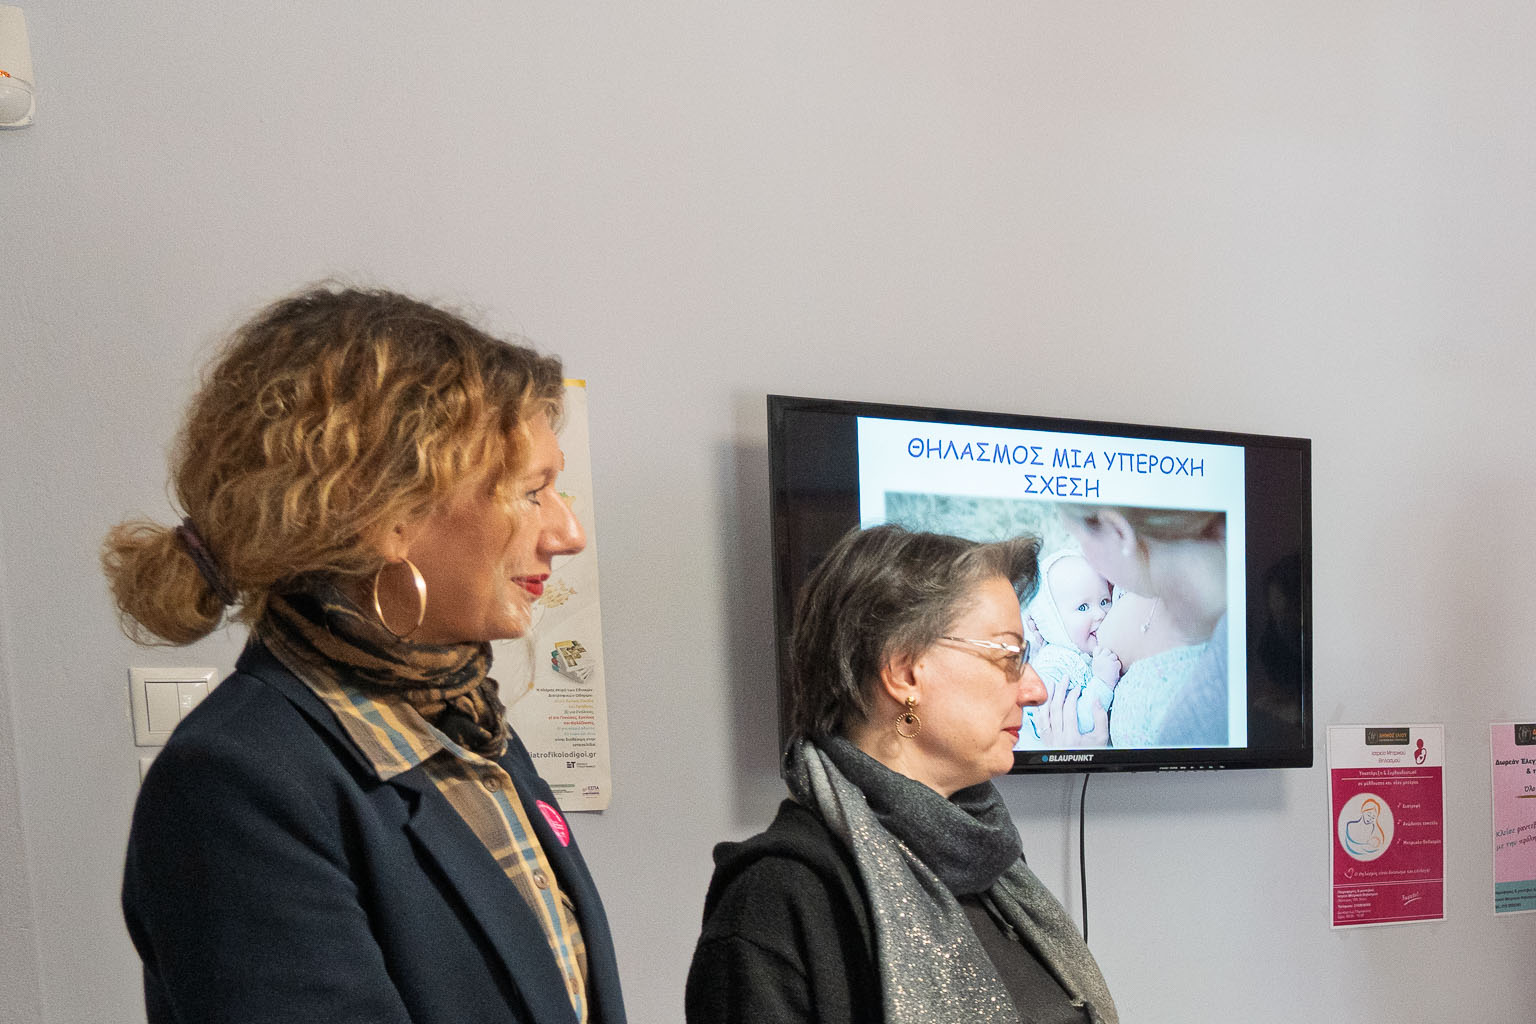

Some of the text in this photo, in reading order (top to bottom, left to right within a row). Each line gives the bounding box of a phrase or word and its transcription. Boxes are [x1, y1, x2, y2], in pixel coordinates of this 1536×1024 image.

[908, 437, 1205, 477] ΘΗΛΑΣΜΟΣ ΜΙΑ ΥΠΕΡΟΧΗ
[1024, 474, 1100, 498] ΣΧΕΣΗ
[1048, 754, 1094, 762] BLAUPUNKT
